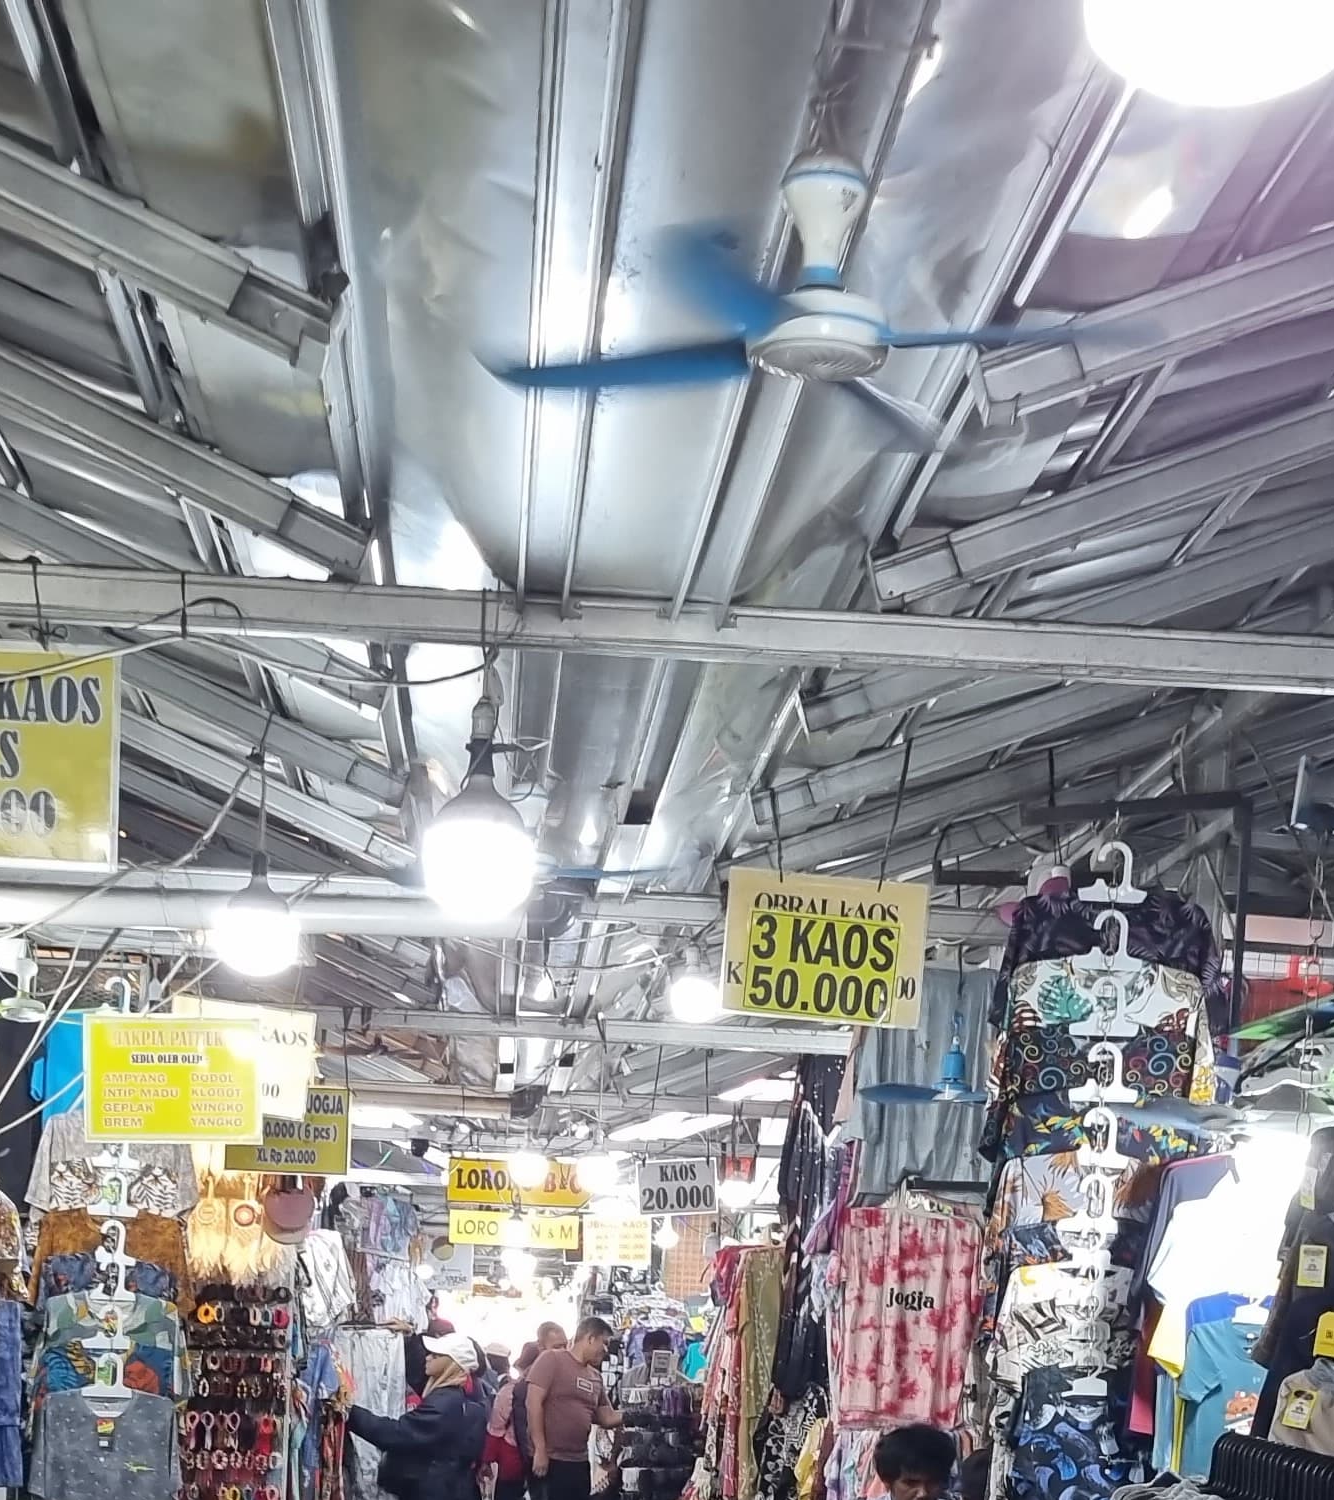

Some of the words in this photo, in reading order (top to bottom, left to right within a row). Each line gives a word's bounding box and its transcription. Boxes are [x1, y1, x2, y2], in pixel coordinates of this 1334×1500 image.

[752, 914, 778, 959] 3
[789, 918, 895, 972] KAOS
[748, 965, 888, 1019] 50.000
[131, 1053, 155, 1064] SEDIA
[157, 1054, 179, 1064] OLEH
[103, 1073, 166, 1083] AMPYANG
[191, 1073, 234, 1083] DODOL
[103, 1088, 134, 1098] INTIP
[140, 1088, 179, 1098] MADU
[191, 1088, 241, 1097] KLOBOT
[103, 1103, 153, 1112] GEPLAK
[191, 1103, 244, 1112] WINGKO
[307, 1093, 344, 1114] JOGJA
[103, 1117, 143, 1127] BREM
[191, 1117, 243, 1127] YANGKO
[257, 1149, 268, 1162] XL
[270, 1150, 282, 1165] Rp
[284, 1151, 316, 1164] 20.000
[659, 1163, 697, 1182] KAOS
[456, 1167, 531, 1191] LORO
[641, 1184, 715, 1212] 20.000
